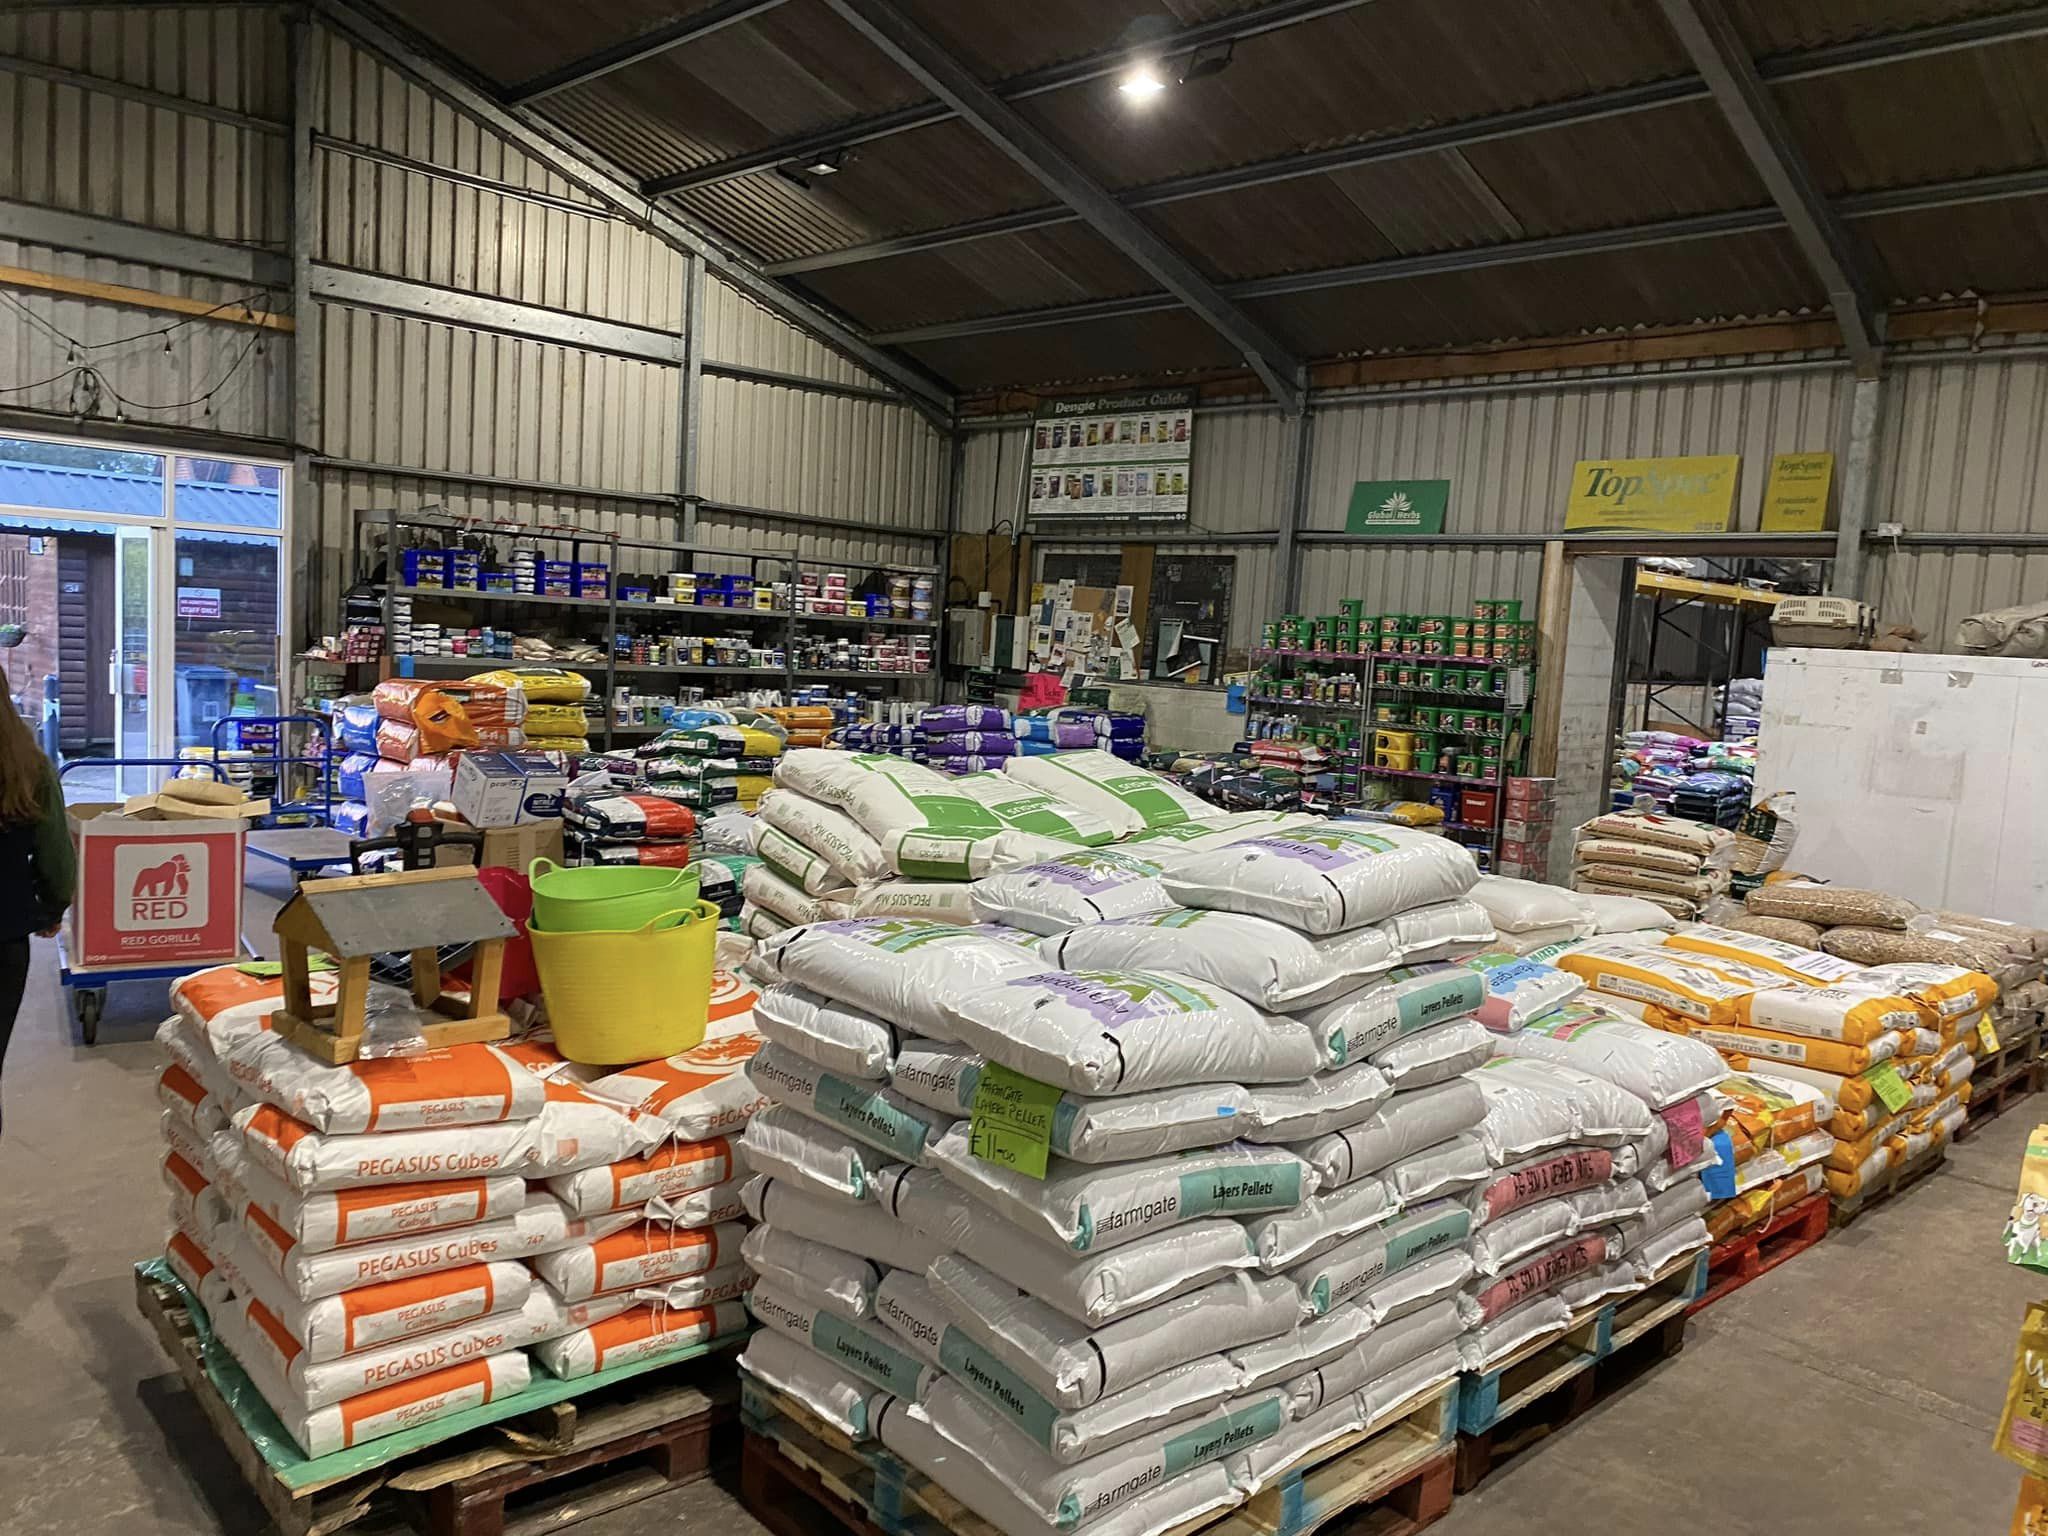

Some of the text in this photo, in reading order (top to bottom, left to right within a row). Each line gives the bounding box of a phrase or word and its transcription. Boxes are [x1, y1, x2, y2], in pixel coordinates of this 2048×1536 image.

[1055, 400, 1095, 414] Dengie
[1367, 510, 1392, 520] Global
[132, 901, 188, 921] RED
[891, 894, 932, 907] PEGASUS
[121, 933, 201, 946] RED GORILLA
[1356, 993, 1464, 1046] farmgate Layers Pellets
[905, 1062, 956, 1092] farmgate
[420, 1101, 465, 1114] PEGASUS
[763, 1061, 896, 1138] farmgate Layers Pellets
[357, 1154, 441, 1177] PEGASUS
[446, 1151, 499, 1171] Cubes
[654, 1166, 694, 1183] PEGASUS
[661, 1180, 687, 1192] Cubes
[391, 1200, 439, 1217] PEGASUS
[1110, 1195, 1177, 1230] farmgate
[1241, 1181, 1273, 1196] Pellets
[357, 1234, 545, 1278] PEGASUS Cubes 747
[639, 1252, 679, 1268] PEGASUS
[1340, 1261, 1384, 1295] farmgate
[397, 1301, 446, 1322] PEGASUS
[639, 1335, 680, 1352] PEGASUS
[762, 1296, 893, 1378] farmgate Layers Pellets
[364, 1323, 548, 1385] PEGASUS Cubes 747
[888, 1298, 1024, 1416] farmgate Layers Pellets
[396, 1397, 445, 1421] PEGASUS
[1193, 1439, 1222, 1459] Layers
[1223, 1423, 1254, 1448] Pellets
